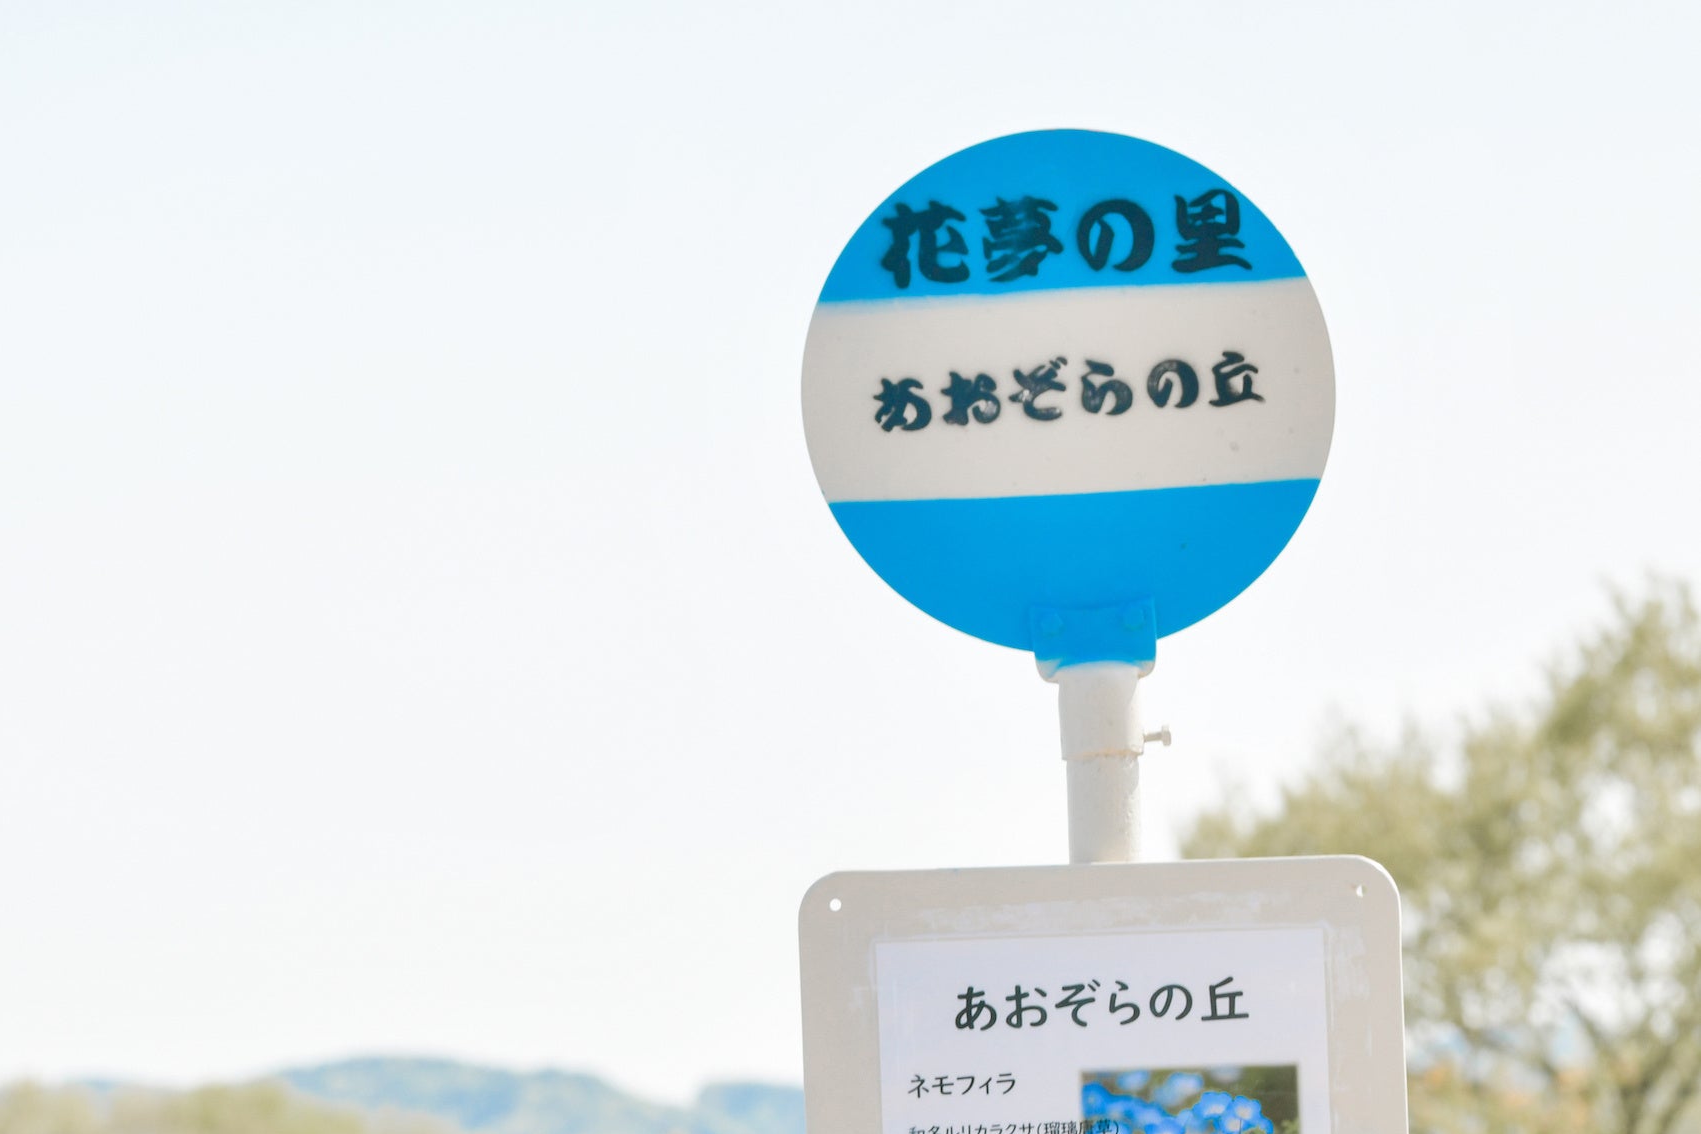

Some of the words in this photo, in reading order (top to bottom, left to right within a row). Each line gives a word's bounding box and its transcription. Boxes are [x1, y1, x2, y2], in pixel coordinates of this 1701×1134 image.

[879, 187, 1253, 290] 花夢の里
[872, 350, 1265, 433] あおぞらの丘
[954, 976, 1250, 1031] あおぞらの丘
[907, 1072, 1017, 1099] ネモフィラ
